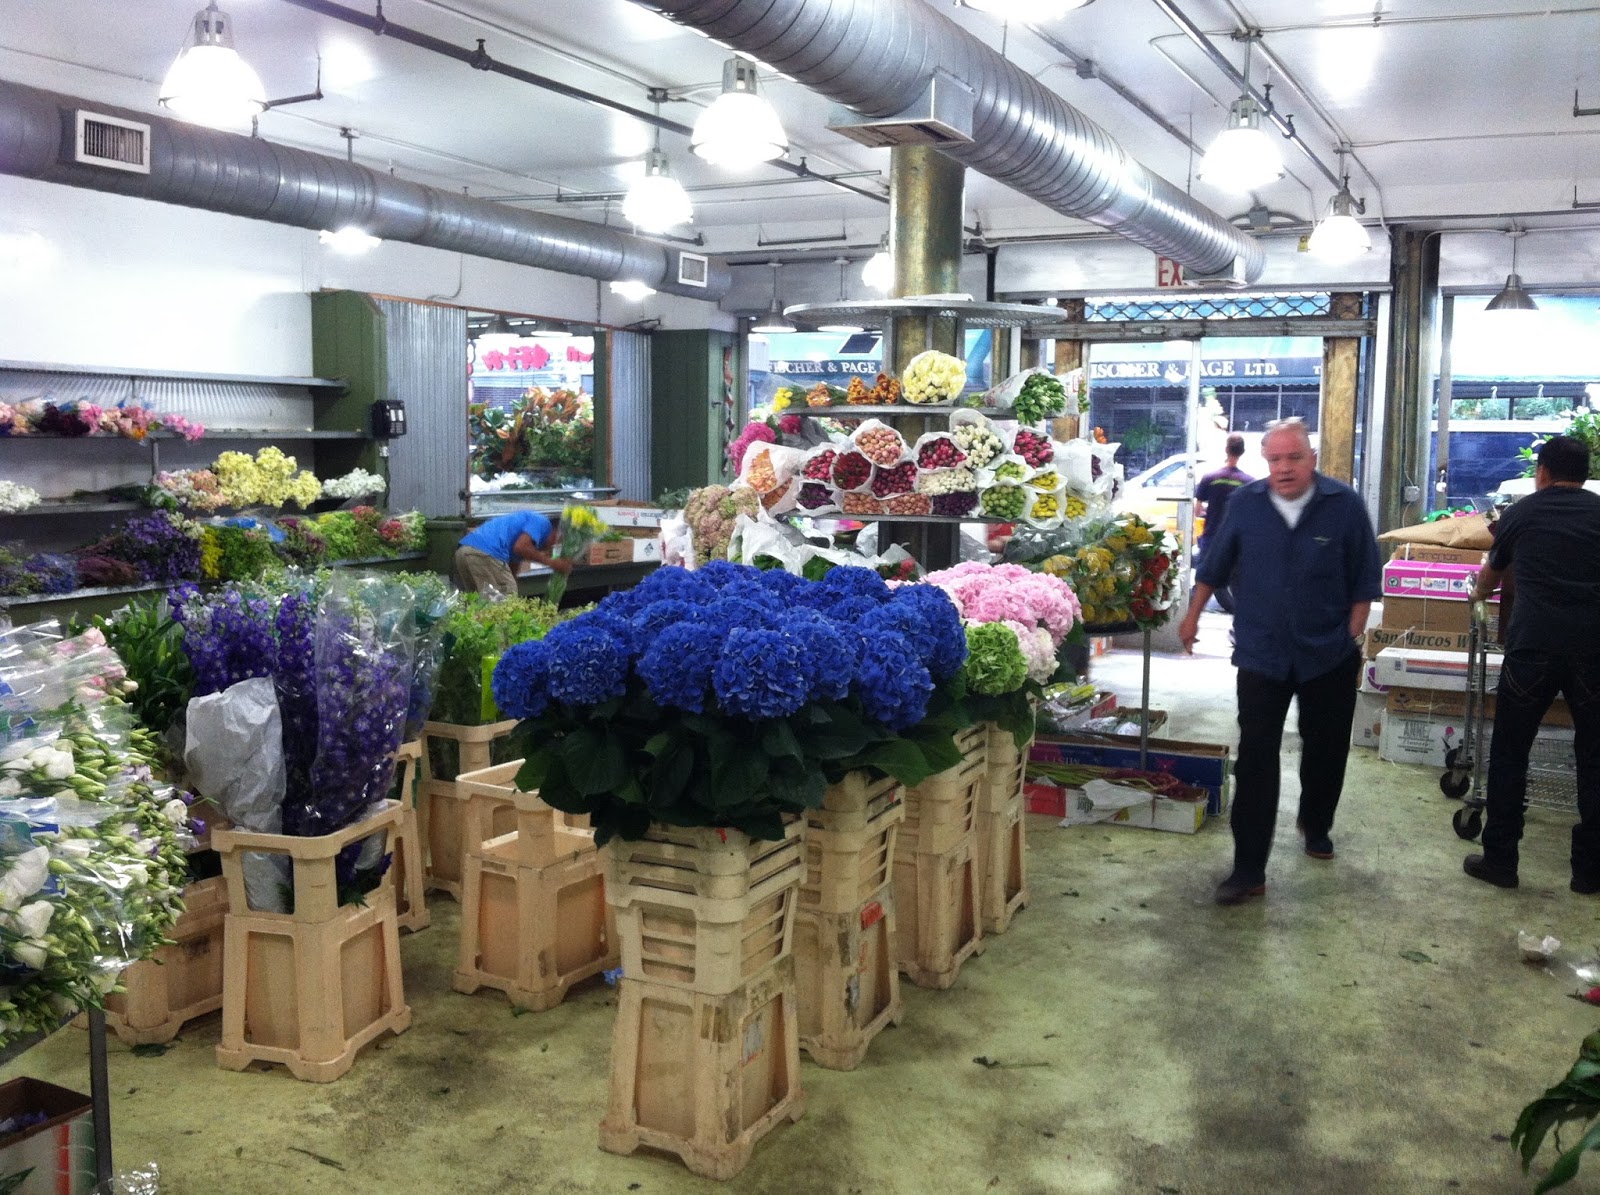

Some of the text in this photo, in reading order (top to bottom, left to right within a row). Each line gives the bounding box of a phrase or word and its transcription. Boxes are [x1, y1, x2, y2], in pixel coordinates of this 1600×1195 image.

[827, 362, 838, 373] &
[841, 361, 877, 374] PAGE
[1244, 363, 1280, 376] LTD.
[1372, 629, 1399, 644] San
[1401, 632, 1452, 648] Marcos
